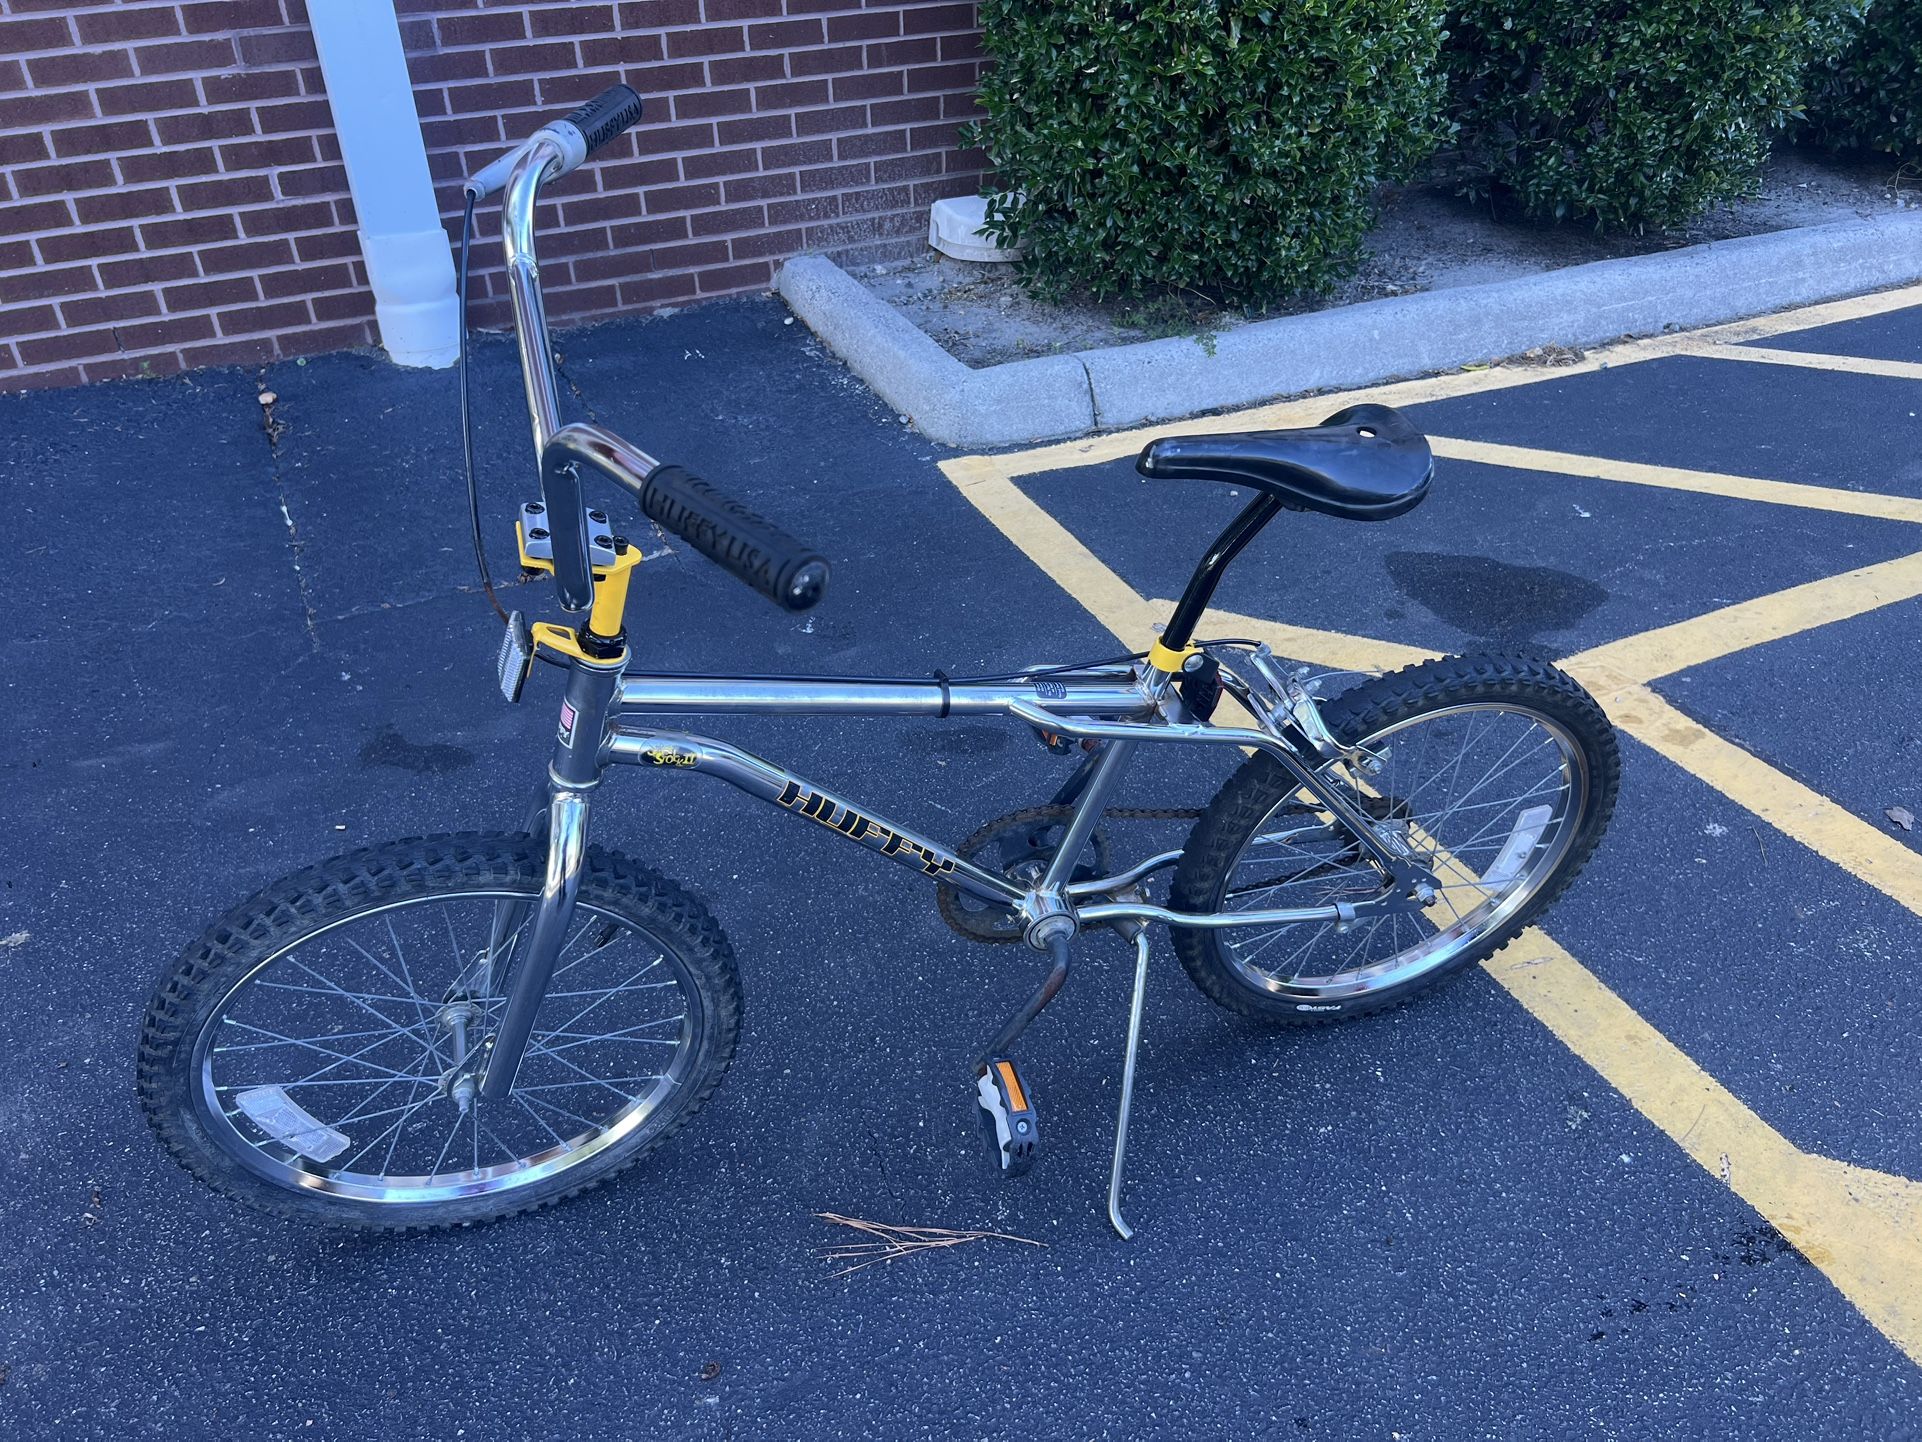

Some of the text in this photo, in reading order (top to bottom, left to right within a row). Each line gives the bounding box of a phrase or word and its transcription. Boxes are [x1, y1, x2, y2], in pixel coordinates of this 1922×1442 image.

[649, 487, 772, 587] HUFFY USA
[778, 780, 955, 875] HUFFY
